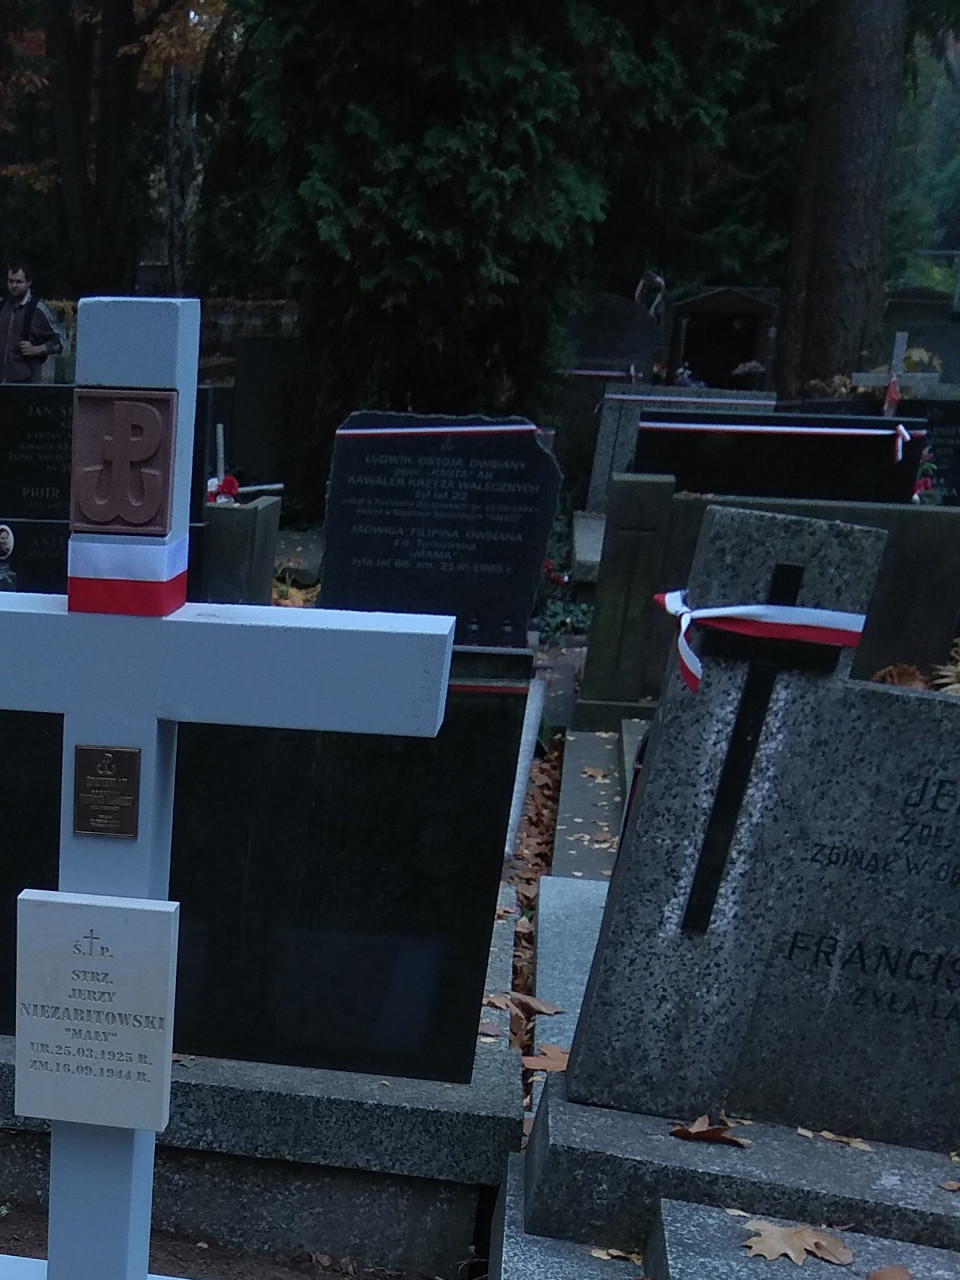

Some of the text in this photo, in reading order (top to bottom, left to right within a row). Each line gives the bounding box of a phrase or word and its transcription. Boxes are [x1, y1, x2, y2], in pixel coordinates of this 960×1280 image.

[347, 475, 405, 487] KAWALER
[351, 524, 404, 536] JADWIGA
[73, 940, 114, 959] Ś. P.
[71, 969, 114, 985] STRZ.
[68, 988, 117, 1004] JERZY
[19, 1002, 166, 1032] NIEZABITOWSKI
[137, 1053, 153, 1066] R.
[136, 1071, 152, 1084] R.
